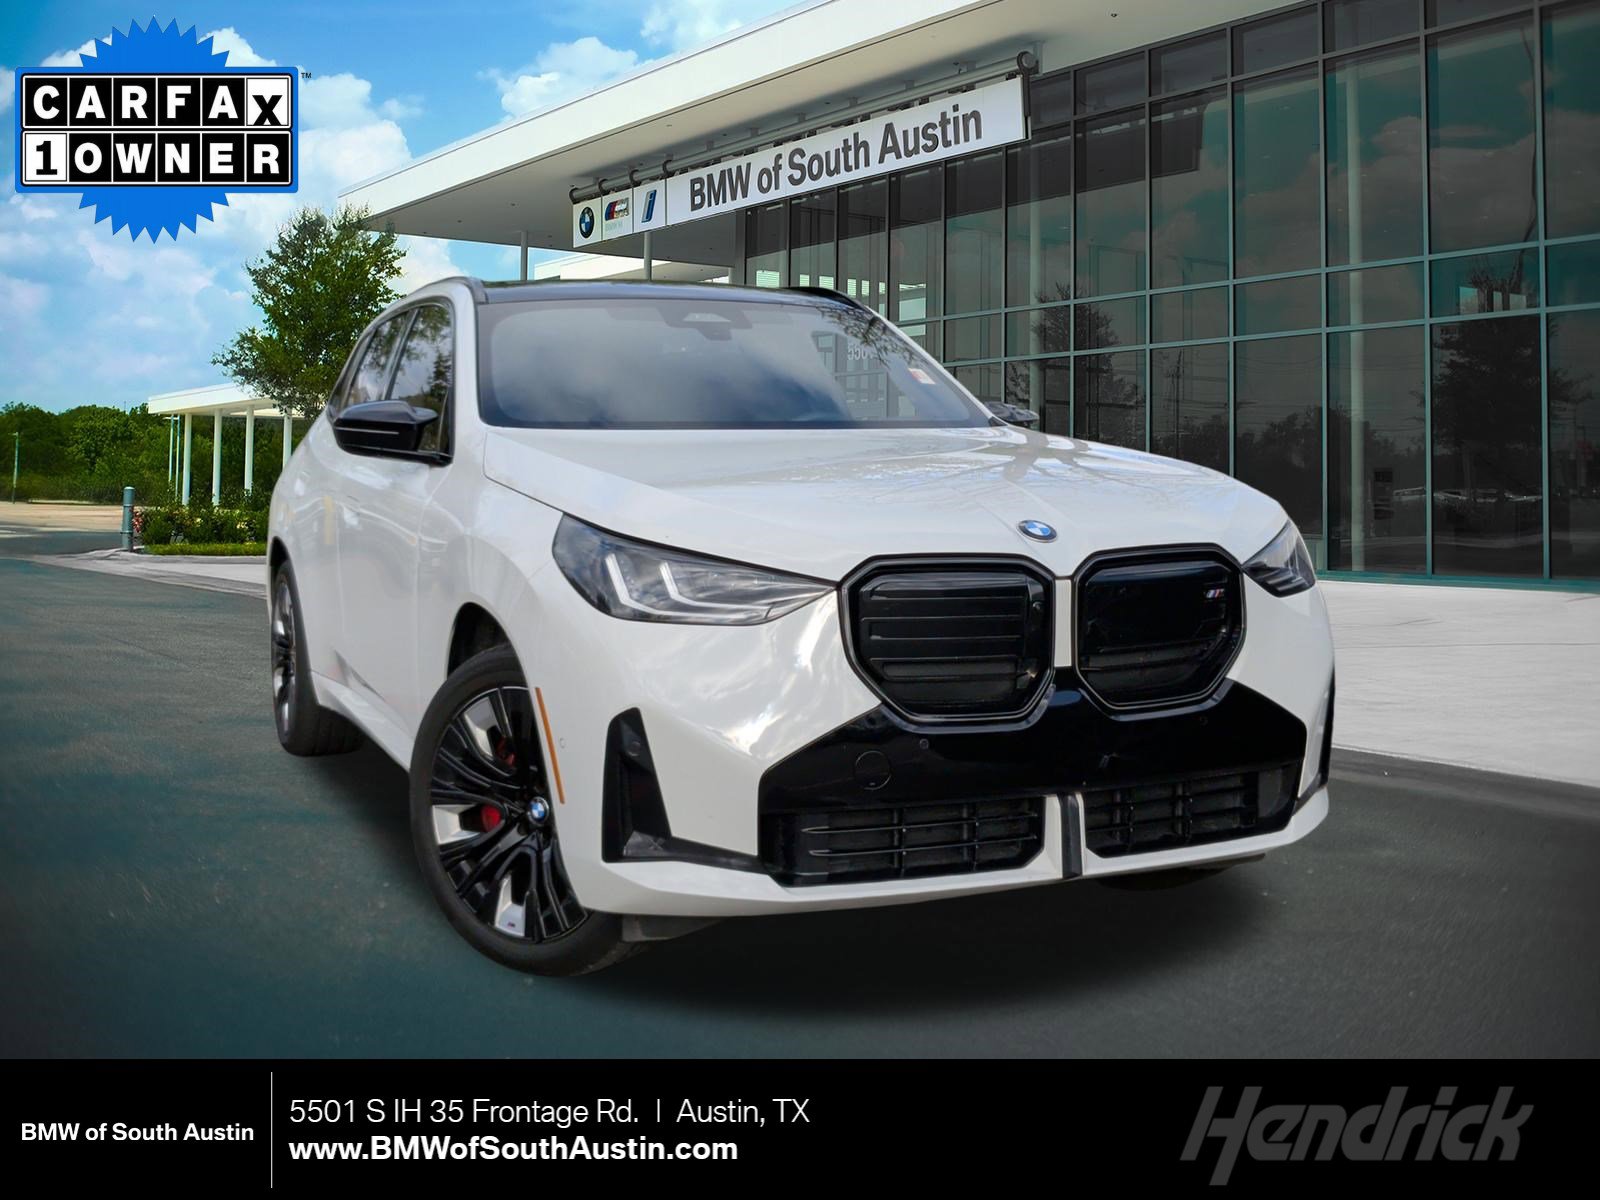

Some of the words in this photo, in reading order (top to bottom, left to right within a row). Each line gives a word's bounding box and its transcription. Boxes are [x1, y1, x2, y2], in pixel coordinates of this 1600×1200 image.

[690, 162, 751, 212] BMW
[757, 153, 782, 194] of
[787, 132, 870, 186] South
[878, 103, 982, 164] Austin
